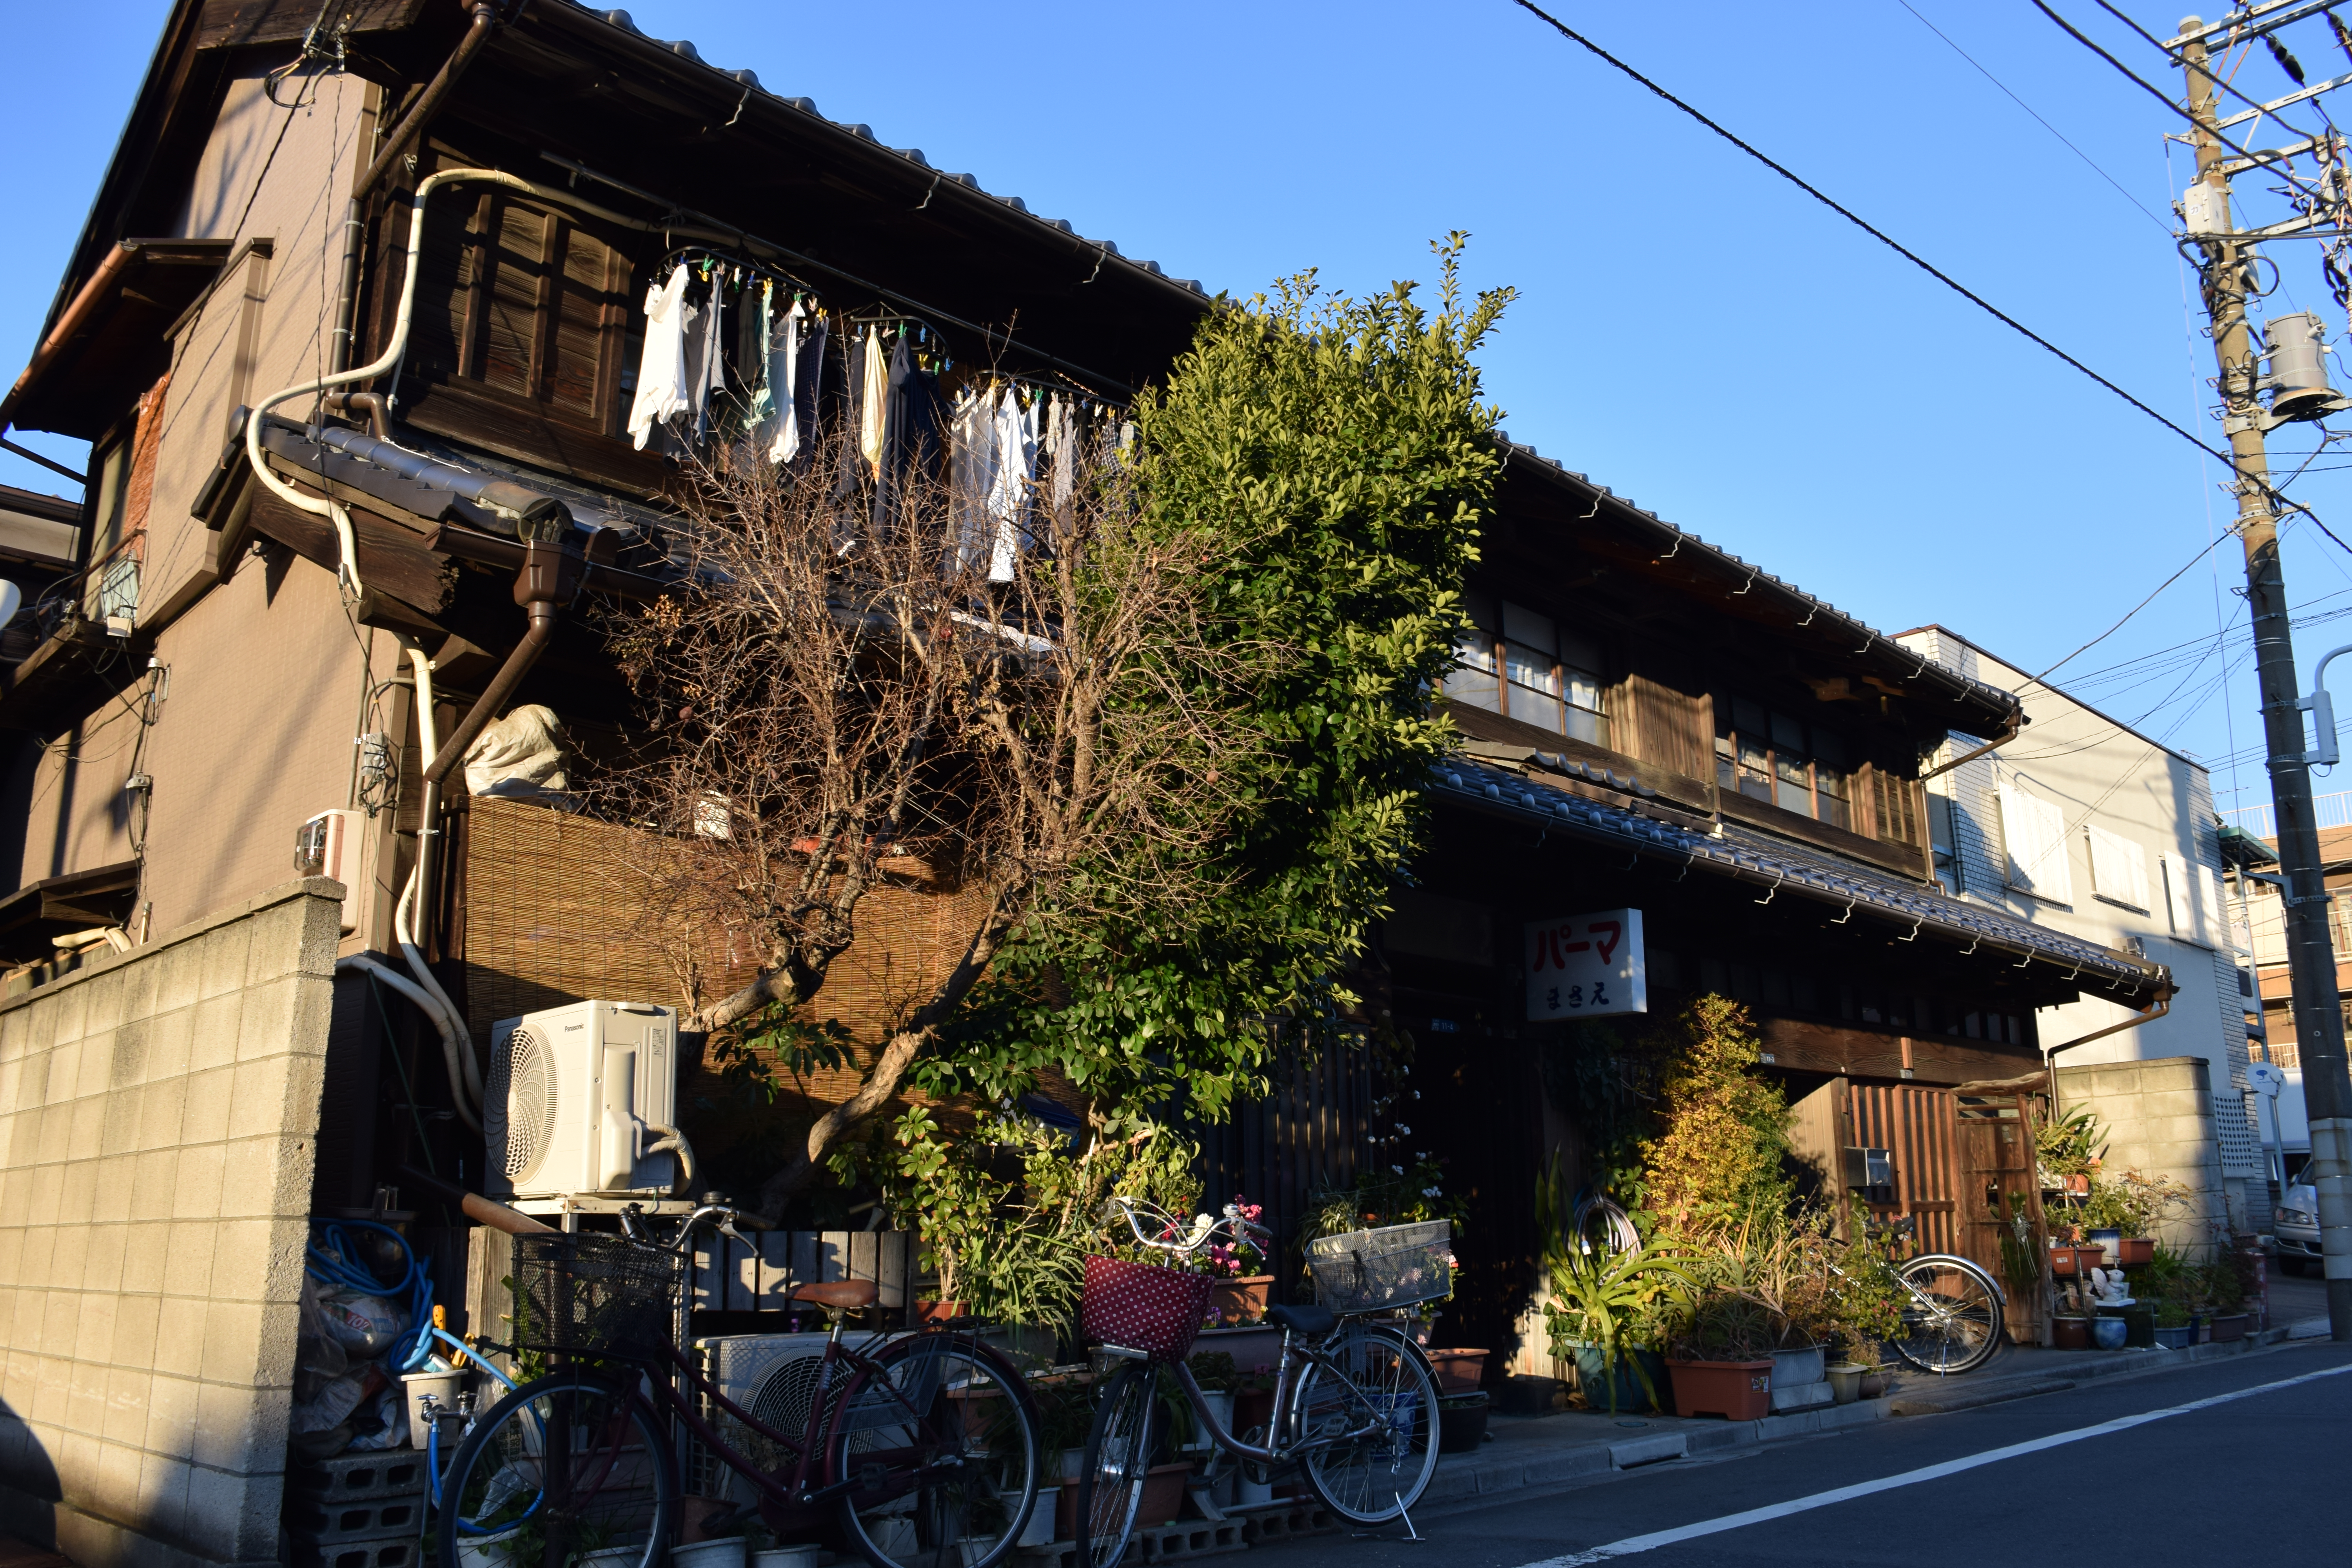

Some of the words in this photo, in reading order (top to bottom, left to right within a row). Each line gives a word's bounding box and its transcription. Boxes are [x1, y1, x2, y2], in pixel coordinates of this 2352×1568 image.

[1533, 920, 1621, 972] パーマ
[1547, 982, 1610, 1010] まさえ
[564, 1022, 584, 1033] Panasonic
[1442, 1022, 1453, 1031] 11-4
[823, 1365, 834, 1389] arnest
